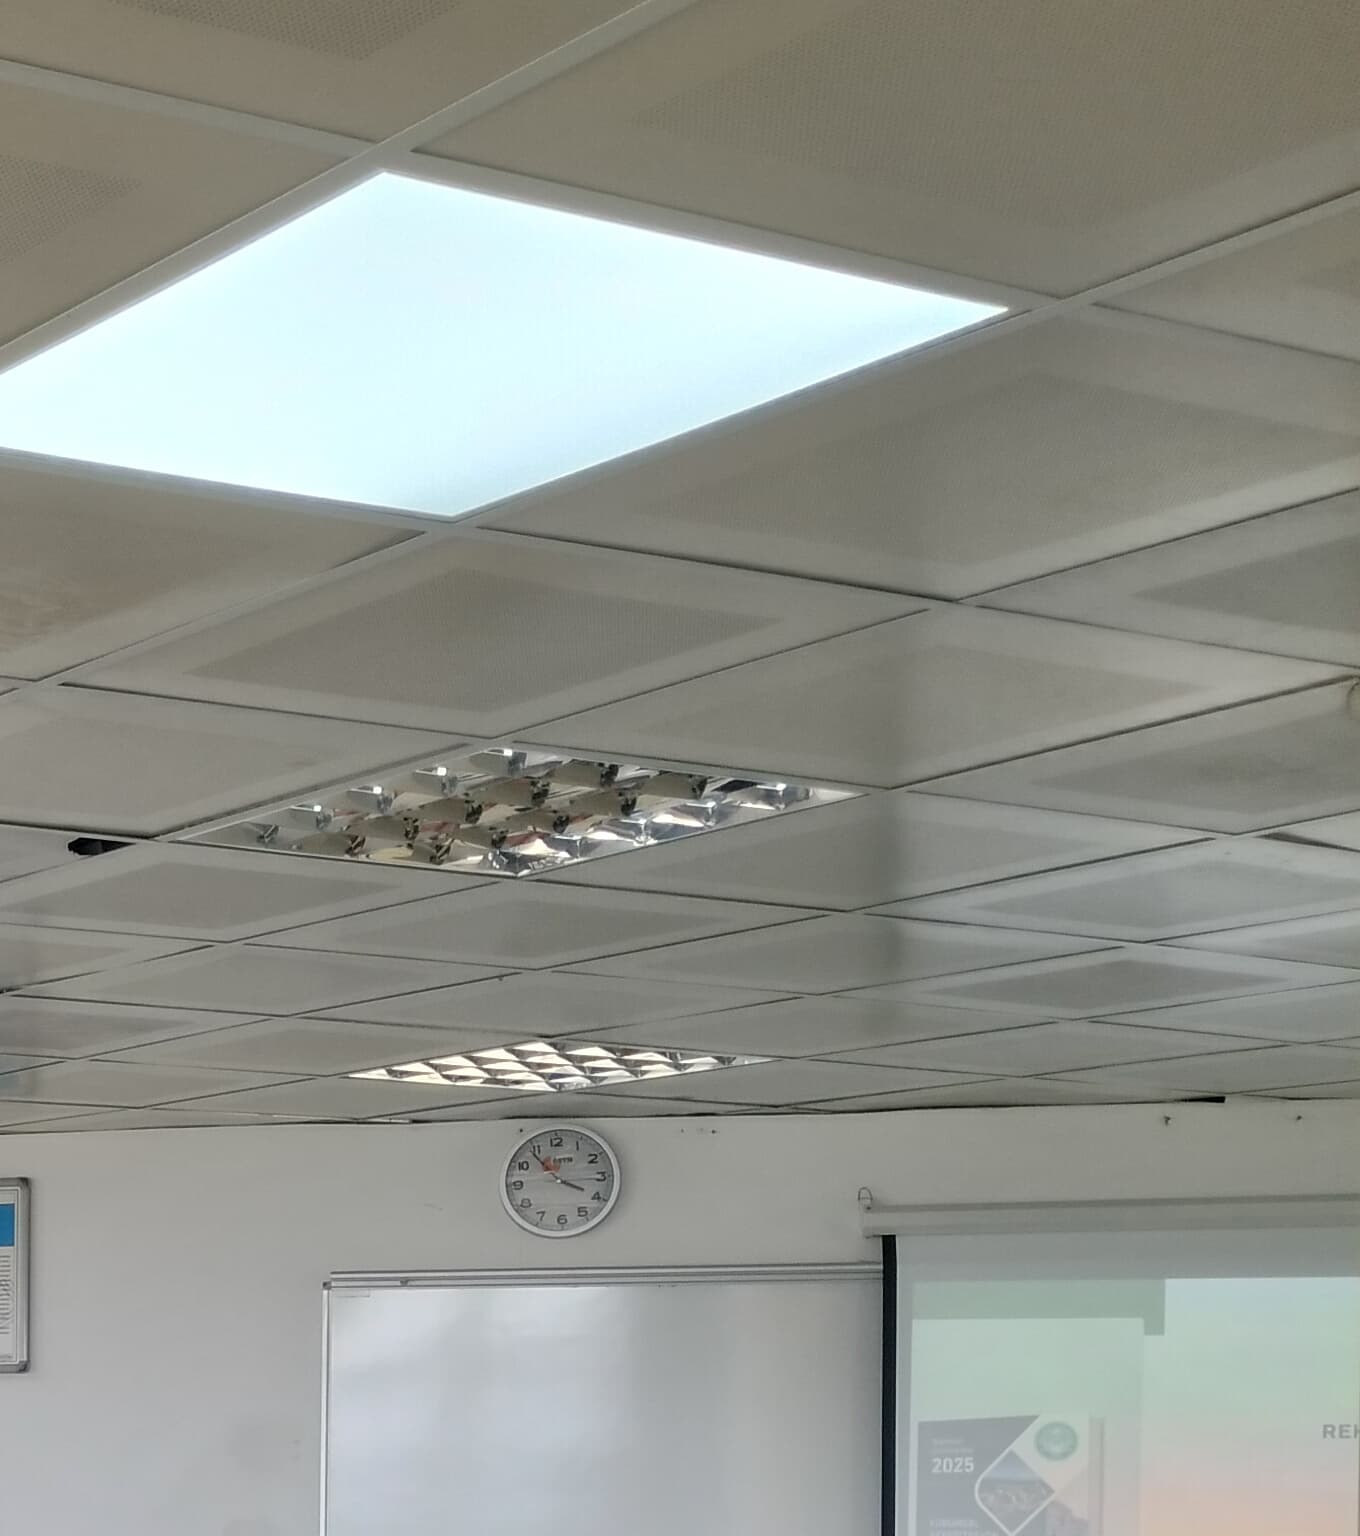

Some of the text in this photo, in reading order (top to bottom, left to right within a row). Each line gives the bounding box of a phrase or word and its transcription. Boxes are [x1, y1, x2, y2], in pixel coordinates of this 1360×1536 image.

[550, 1137, 563, 1147] 12
[532, 1145, 541, 1154] 11
[588, 1153, 599, 1164] 2
[518, 1160, 529, 1171] 10
[595, 1171, 606, 1182] 3
[512, 1180, 523, 1190] 9
[591, 1191, 601, 1200] 4
[536, 1211, 546, 1221] 7
[577, 1206, 588, 1217] 5
[557, 1214, 568, 1225] 6
[931, 1457, 975, 1473] 2025
